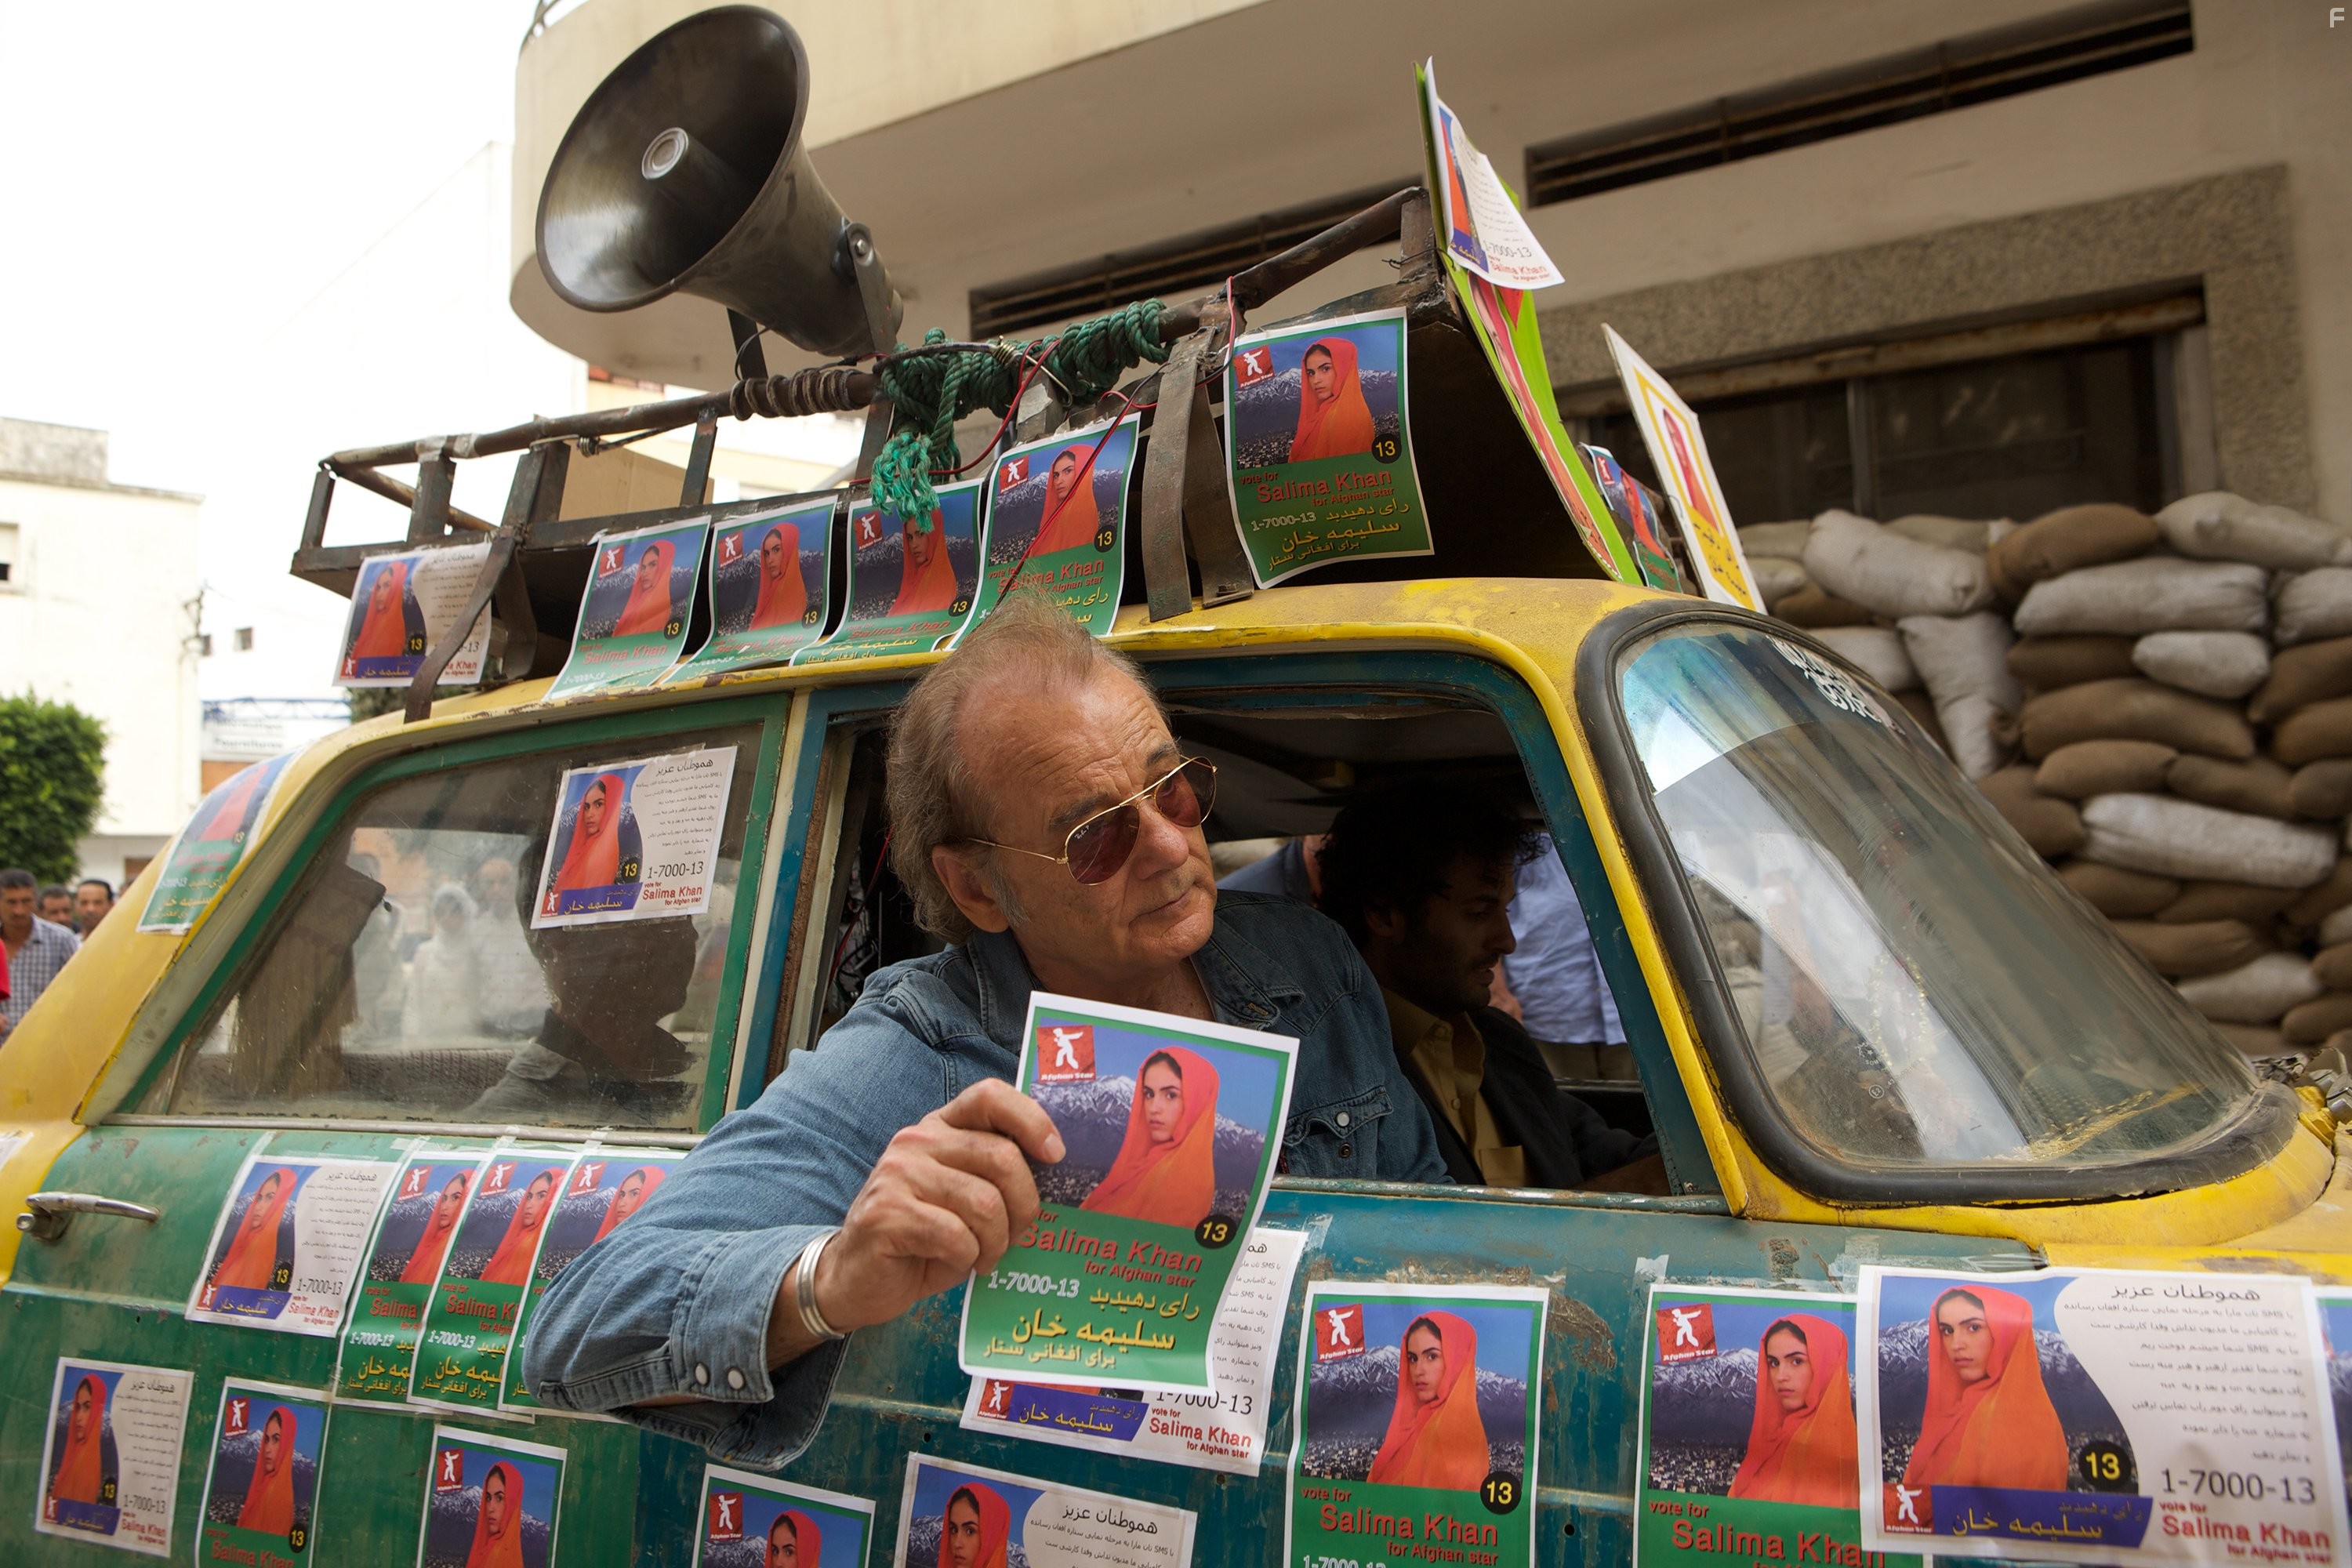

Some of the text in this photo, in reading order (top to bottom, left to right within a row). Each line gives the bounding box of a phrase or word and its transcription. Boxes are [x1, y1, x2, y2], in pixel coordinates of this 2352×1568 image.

[1375, 441, 1396, 457] 13
[1241, 472, 1279, 485] vote for
[1258, 471, 1392, 503] Salima Khan
[1312, 488, 1395, 507] for Afghan star
[1379, 498, 1410, 515] رای
[1250, 512, 1317, 532] 1-7000-13
[1097, 531, 1112, 547] 13
[1281, 521, 1401, 553] سلیمه خان
[1338, 540, 1361, 551] برای
[989, 570, 1004, 579] vote
[1061, 559, 1105, 581] Khan
[1052, 575, 1104, 593] Afghan star
[1083, 587, 1109, 607] رای
[953, 601, 968, 614] 13
[804, 611, 818, 625] 13
[666, 622, 680, 636] 13
[848, 620, 951, 640] Salima Khan
[411, 638, 423, 651] 13
[583, 644, 667, 666] Salima Khan
[456, 660, 477, 670] Khan
[624, 863, 638, 877] 13
[647, 861, 704, 880] 1-7000-13
[642, 886, 702, 901] Salima Khan
[1040, 1073, 1073, 1081] Afghan
[1201, 1220, 1228, 1243] 13
[1019, 1223, 1203, 1272] Salima Khan
[276, 1269, 289, 1283] 13
[1084, 1260, 1196, 1287] for Afghan star
[296, 1277, 344, 1296] 1-7000-13
[441, 1283, 470, 1294] vote for
[988, 1271, 1080, 1298] 1-7000-13
[2111, 1284, 2261, 1302] هموطنان عزیز
[369, 1298, 417, 1319] Salima
[445, 1294, 497, 1320] Salima
[1160, 1292, 1200, 1320] رای
[479, 1320, 492, 1332] for
[1011, 1308, 1176, 1353] سلیمه خان
[350, 1331, 394, 1348] 1-7000-13
[427, 1330, 477, 1349] 1-7000-13
[983, 1336, 1117, 1369] برای افغانی ستار
[1319, 1346, 1364, 1360] Afghan Star
[1663, 1352, 1694, 1361] Afghan
[358, 1355, 387, 1380] خان
[434, 1356, 463, 1381] خان
[1018, 1403, 1114, 1434] سلیمه خان
[1151, 1407, 1168, 1417] vote
[1149, 1417, 1252, 1448] Salima Khan
[1187, 1441, 1250, 1459] for Afghan star
[2085, 1452, 2121, 1480] 13
[1301, 1486, 1352, 1501] vote for
[1486, 1481, 1513, 1504] 13
[2161, 1468, 2316, 1504] 1-7000-13
[124, 1494, 166, 1515] 1-7000-13
[1649, 1500, 1710, 1518] vote for
[2160, 1501, 2208, 1515] vote for
[1062, 1505, 1158, 1535] هموطنان عزیز
[1319, 1504, 1498, 1547] Salima Khan
[1952, 1507, 2103, 1543] سلیمه خان
[291, 1530, 305, 1547] 13
[1671, 1519, 1786, 1560] Salima
[2162, 1515, 2332, 1549] Salima Khan
[212, 1539, 295, 1568] Salima Khan
[1154, 1545, 1169, 1556] SMS
[1386, 1540, 1499, 1566] for Afghan star
[2227, 1544, 2332, 1564] for Afghan star
